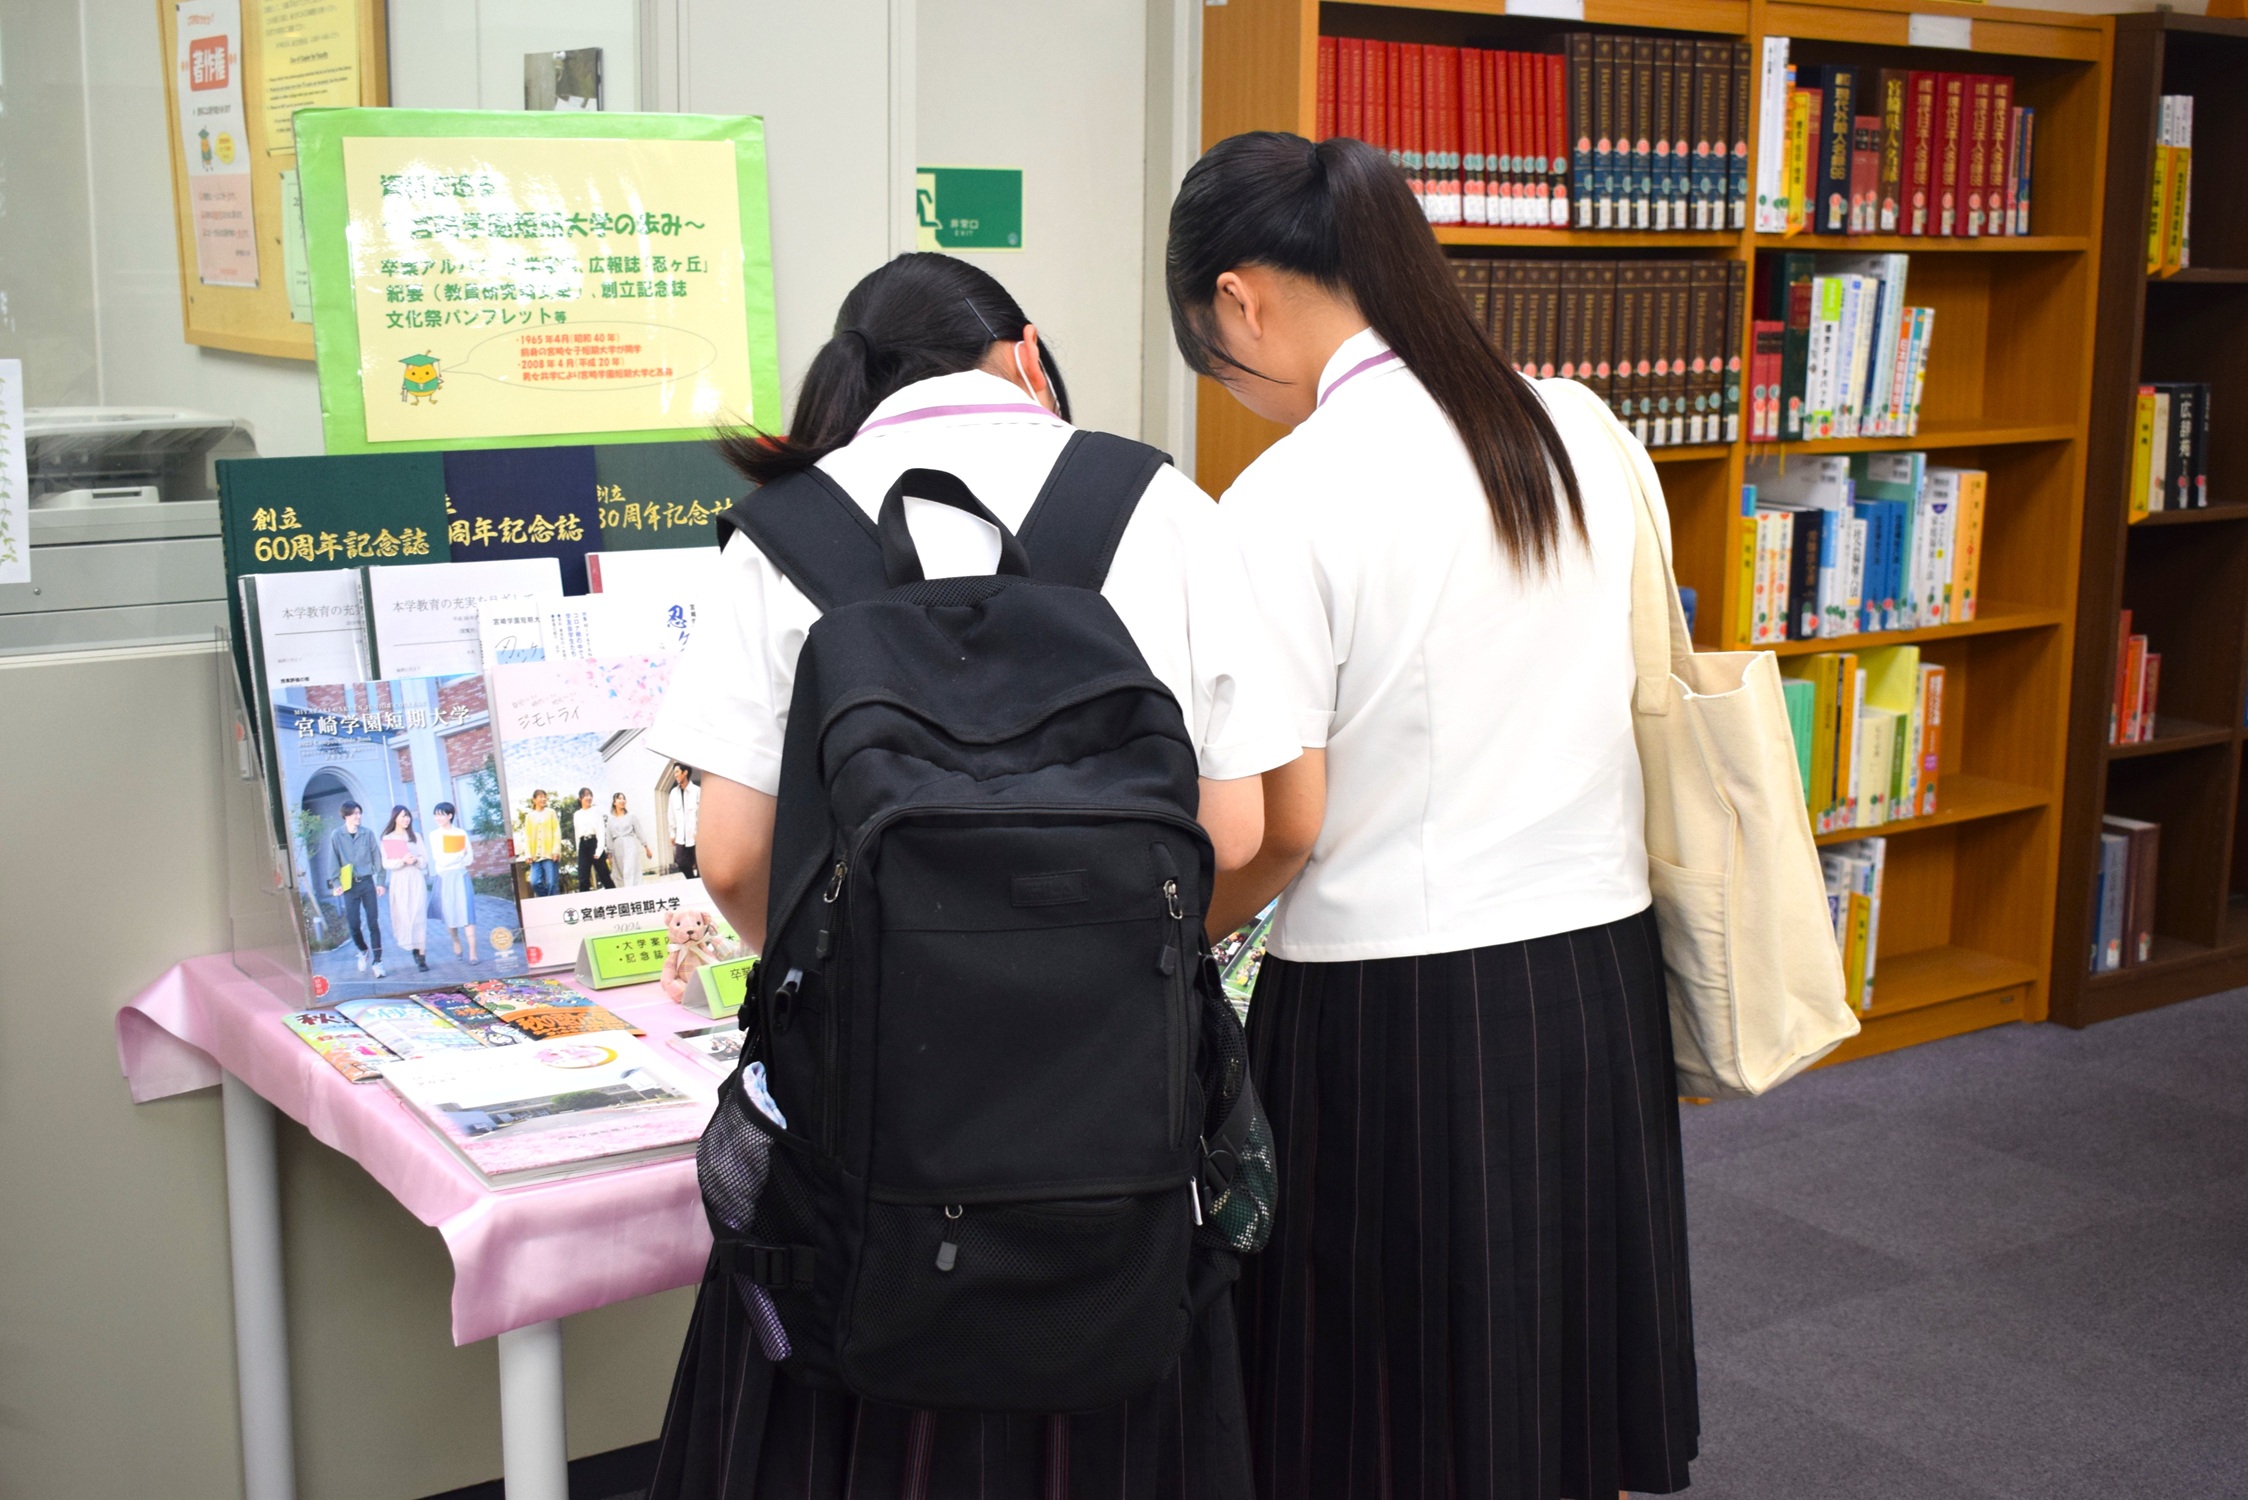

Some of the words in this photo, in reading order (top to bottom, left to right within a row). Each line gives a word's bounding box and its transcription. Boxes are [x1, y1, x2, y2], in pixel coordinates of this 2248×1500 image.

[251, 506, 303, 532] 創立
[254, 526, 431, 563] 60周年記念誌
[294, 704, 471, 739] 宮崎学園短期大学
[580, 897, 681, 922] 宮崎学園短期大学
